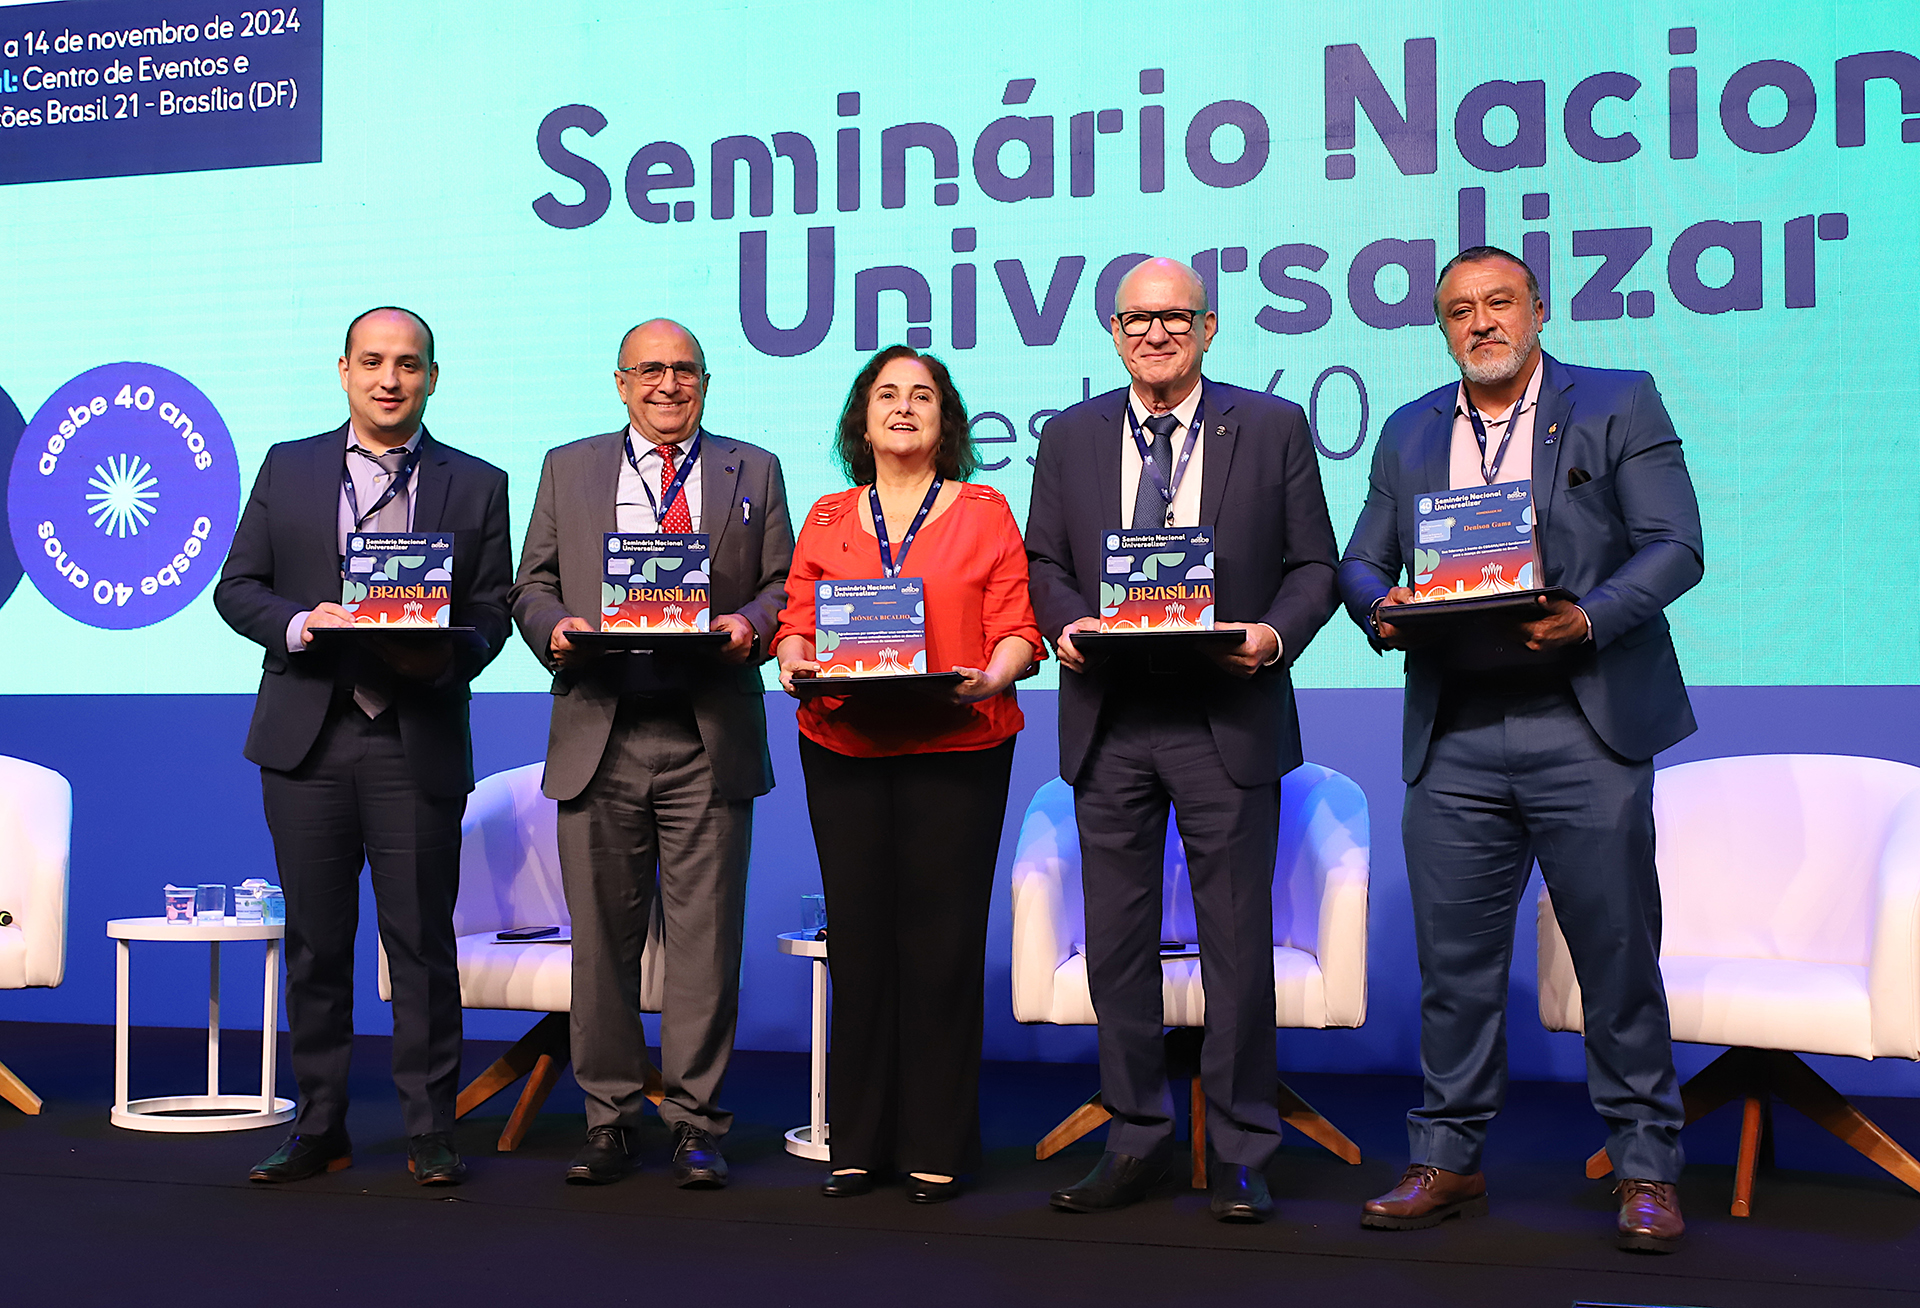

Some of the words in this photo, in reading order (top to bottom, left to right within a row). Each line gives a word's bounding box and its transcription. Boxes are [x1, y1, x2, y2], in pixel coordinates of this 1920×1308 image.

[4, 39, 19, 58] a
[24, 30, 49, 56] 14
[54, 28, 84, 54] de
[87, 20, 199, 51] novembro
[204, 14, 234, 41] de
[240, 7, 301, 38] 2024
[0, 69, 19, 93] l:
[22, 65, 99, 91] Centro
[104, 59, 133, 85] de
[138, 56, 229, 82] Eventos
[233, 55, 249, 73] e
[0, 105, 43, 129] ões
[47, 95, 109, 125] Brasil
[113, 93, 139, 119] 21
[159, 86, 244, 116] Brasília
[249, 78, 298, 112] (DF)
[532, 67, 1270, 229] Seminário
[1324, 26, 1920, 180] Nacion
[39, 396, 108, 476] aesbe
[114, 384, 155, 410] 40
[159, 402, 212, 470] anos
[1469, 490, 1502, 500] Nacional
[1463, 524, 1490, 532] Denison
[1491, 521, 1512, 529] Gama
[38, 520, 89, 589] anos
[141, 516, 211, 595] aesbe
[93, 579, 133, 607] 40
[369, 583, 448, 599] BRASÍLIA
[628, 586, 707, 602] BRASÍLIA
[866, 583, 897, 591] Nacional
[1128, 582, 1212, 601] BRASÍLIA
